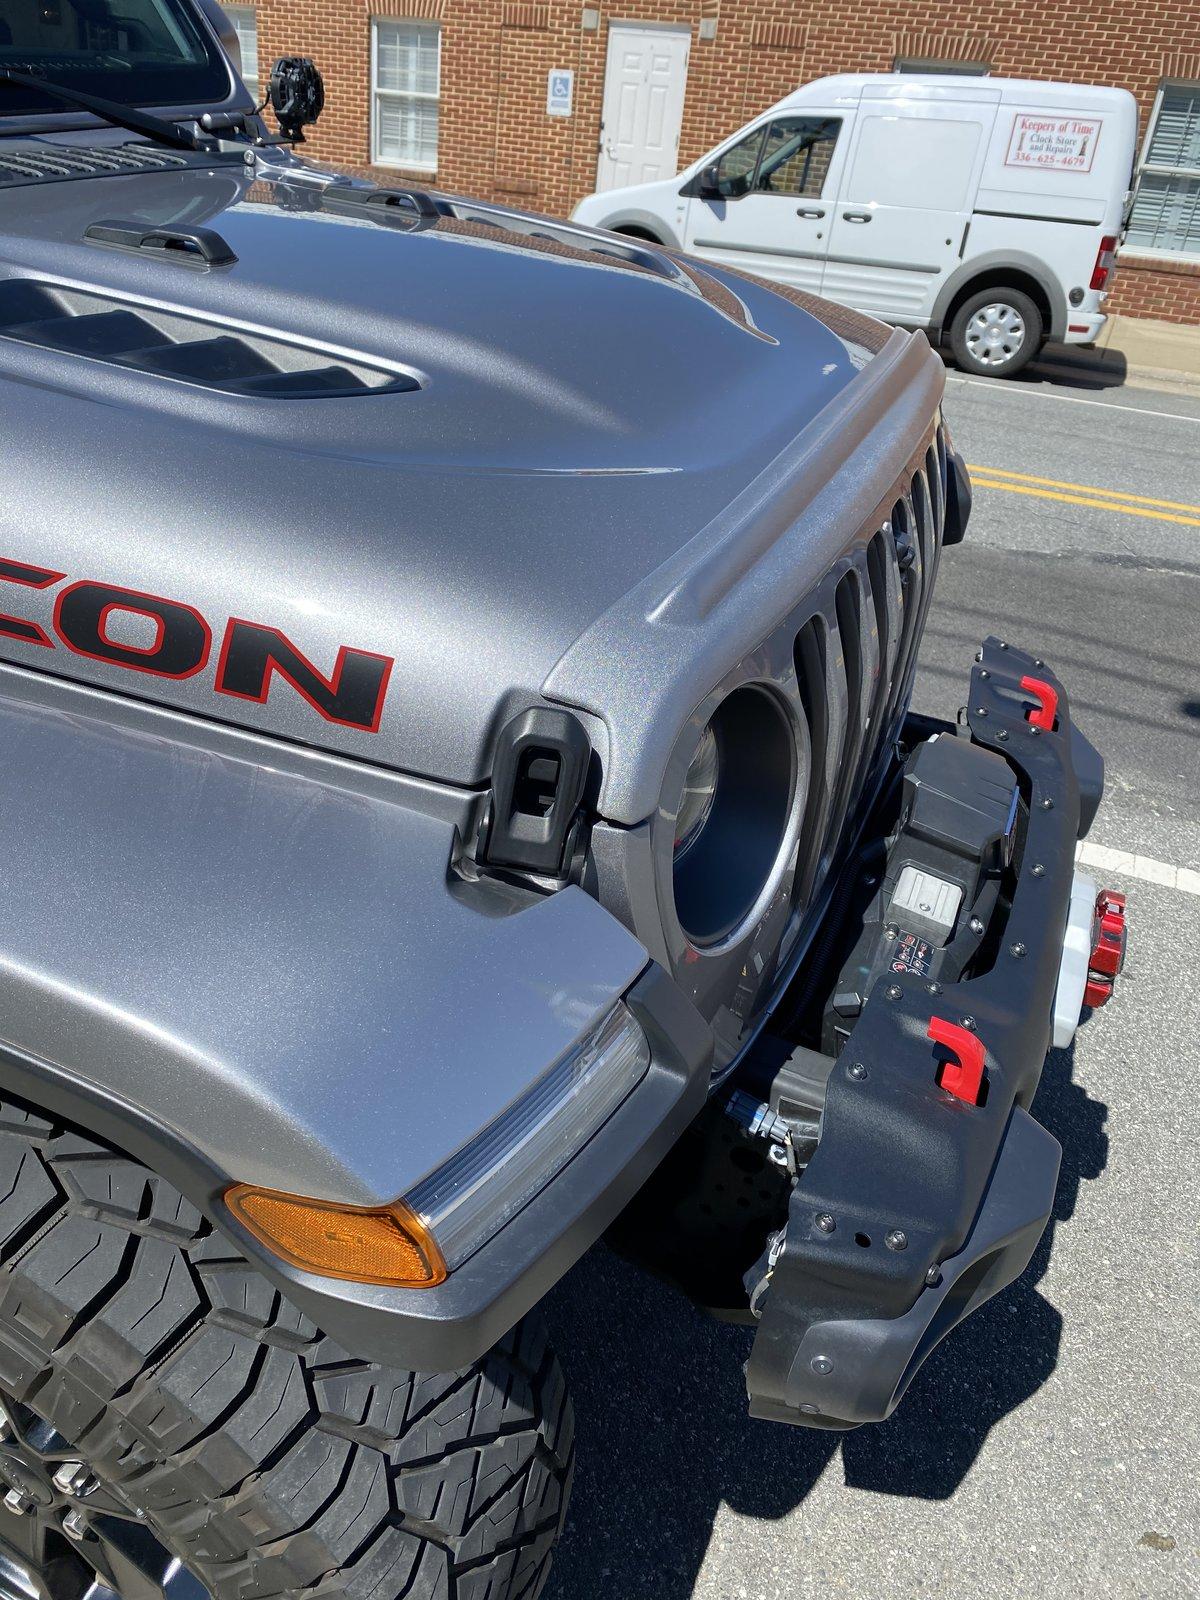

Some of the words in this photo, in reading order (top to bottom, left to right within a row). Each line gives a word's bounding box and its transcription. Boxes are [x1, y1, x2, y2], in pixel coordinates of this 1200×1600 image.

[1021, 118, 1056, 132] Keepers
[1058, 121, 1069, 132] of
[1072, 122, 1094, 134] Time
[1030, 133, 1053, 143] Clock
[1055, 135, 1077, 146] Store
[1029, 143, 1044, 152] and
[1045, 144, 1073, 154] Repairs
